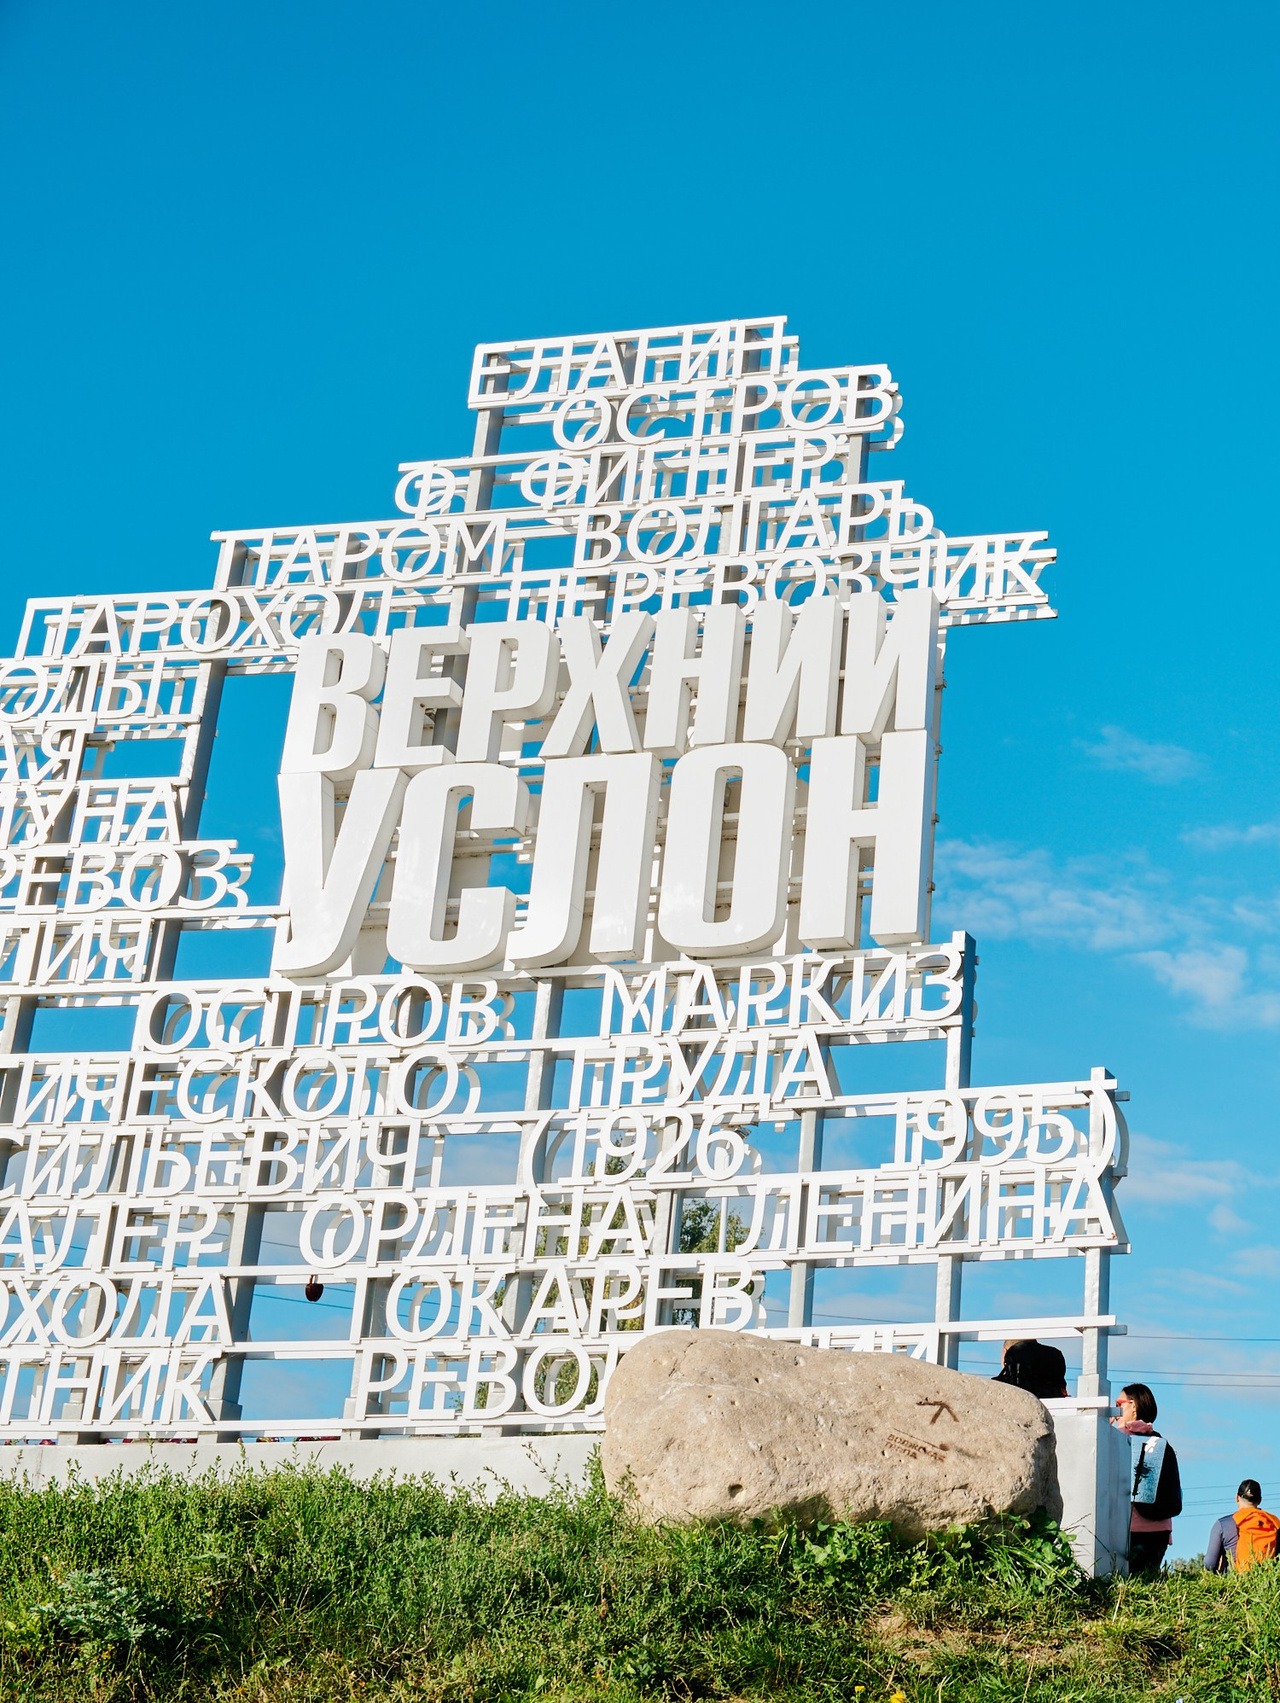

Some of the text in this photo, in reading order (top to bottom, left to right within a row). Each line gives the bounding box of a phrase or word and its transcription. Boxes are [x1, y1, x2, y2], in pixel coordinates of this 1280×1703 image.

[553, 368, 895, 451] ОСТРОВ
[217, 516, 507, 591] ПАРОМ
[505, 537, 1047, 628] ПЕРЕВОЗЧИК
[271, 729, 935, 978] УСЛОН
[142, 951, 963, 1054] ОСТРОВ МАРКИЗ
[0, 1031, 833, 1128] ИЧЕСКОГО ТРУДА
[524, 1105, 746, 1206] (1926
[881, 1087, 1117, 1175] 1995)
[300, 1185, 647, 1269] ОРДЕНА
[735, 1165, 1117, 1257] ЛЕНИНА
[0, 1258, 753, 1348] ХОДА ТОКАРЕВ
